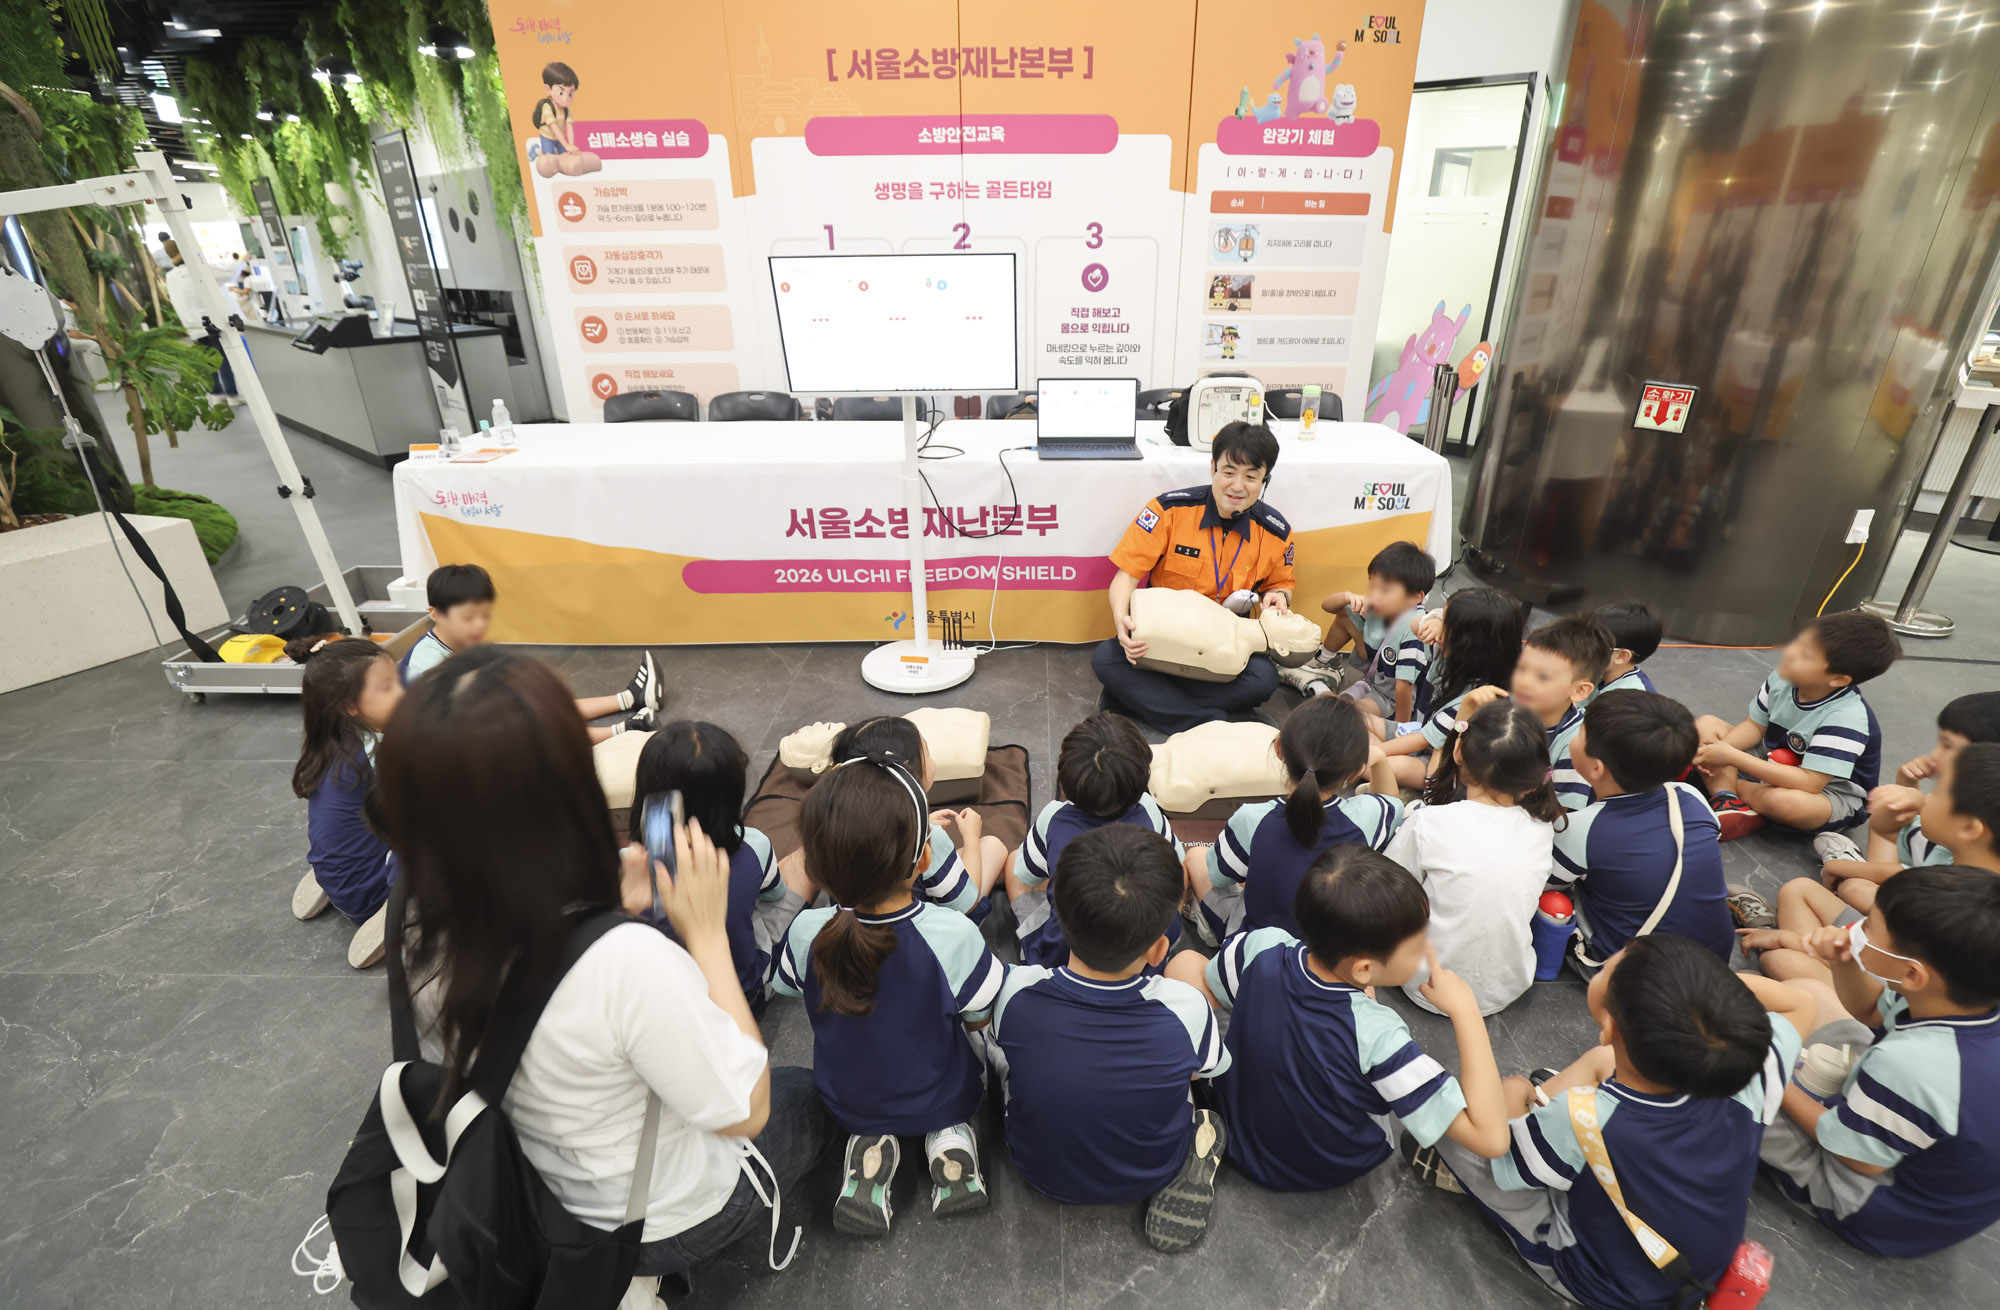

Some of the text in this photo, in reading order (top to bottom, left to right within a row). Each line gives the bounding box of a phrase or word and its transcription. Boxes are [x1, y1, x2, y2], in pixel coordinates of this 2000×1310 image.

[847, 46, 1074, 80] 서울소방재난본부
[587, 130, 690, 149] 심폐소생술 실습
[918, 125, 1005, 144] 소방안전교육
[1263, 128, 1335, 146] 완강기 체험
[593, 187, 628, 197] 가슴압박
[874, 180, 1052, 201] 생명을 구하는 골든타임
[1304, 199, 1317, 208] 하는
[823, 224, 835, 251] 1
[952, 222, 972, 249] 2
[1085, 221, 1104, 249] 3
[614, 311, 676, 321] 이 순서로 하세요
[1070, 307, 1121, 318] 직접 해보고
[1061, 323, 1130, 334] 몸으로 익힙니다
[1046, 343, 1141, 353] 마네킹으로 누르는 깊이와
[1058, 356, 1083, 365] 속도를
[1103, 356, 1128, 365] 봅니다
[624, 369, 675, 379] 직접 해보세요
[1646, 388, 1689, 401] 소화기
[774, 565, 1077, 584] 2026 ULCHI FEEDOM SHIELD
[911, 609, 976, 625] 울특별시
